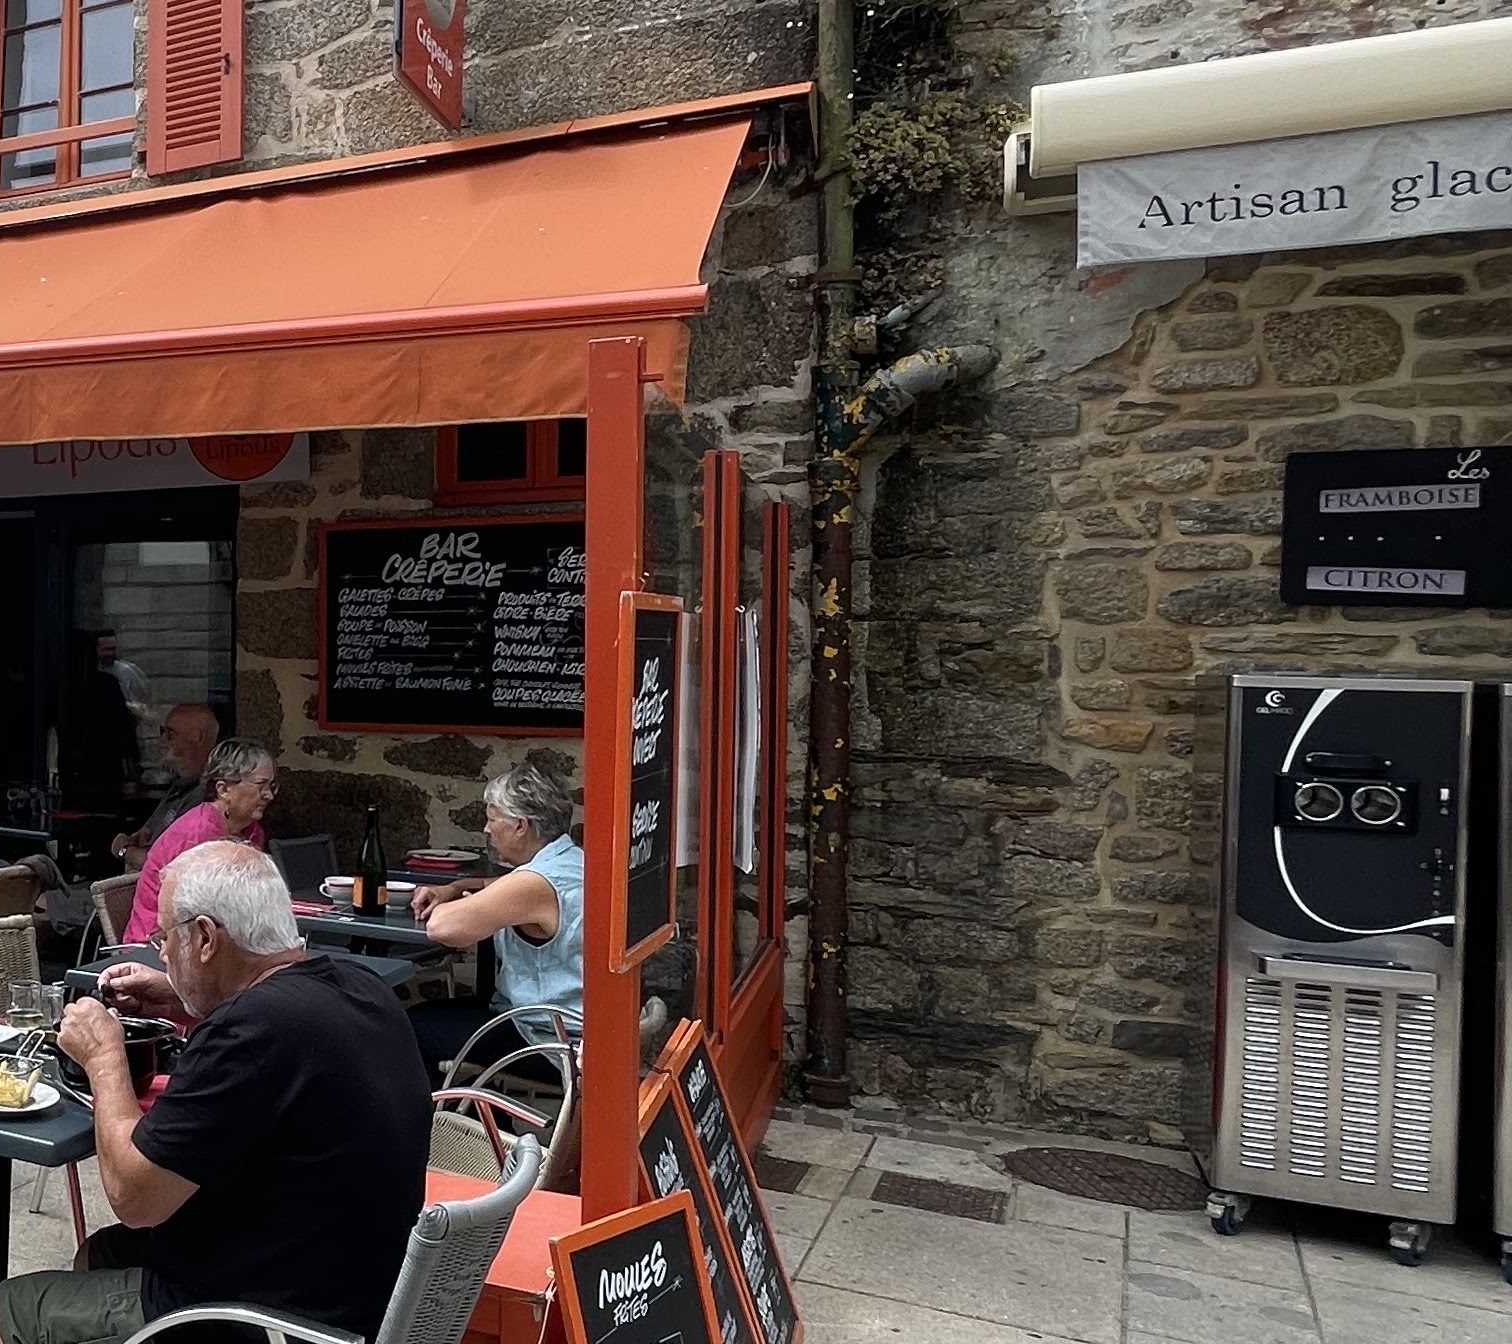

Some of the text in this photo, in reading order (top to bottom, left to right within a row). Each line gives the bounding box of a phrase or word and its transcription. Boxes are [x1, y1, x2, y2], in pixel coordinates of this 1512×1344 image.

[417, 17, 453, 77] Crêperie
[427, 66, 442, 100] Bar
[1138, 183, 1348, 229] Artisan
[1447, 449, 1490, 479] Les
[1324, 487, 1477, 509] FRAMBOISE
[419, 532, 482, 559] BAR
[1323, 568, 1445, 590] CITRON
[598, 1240, 668, 1310] MOULES
[613, 1293, 649, 1328] FRITES
